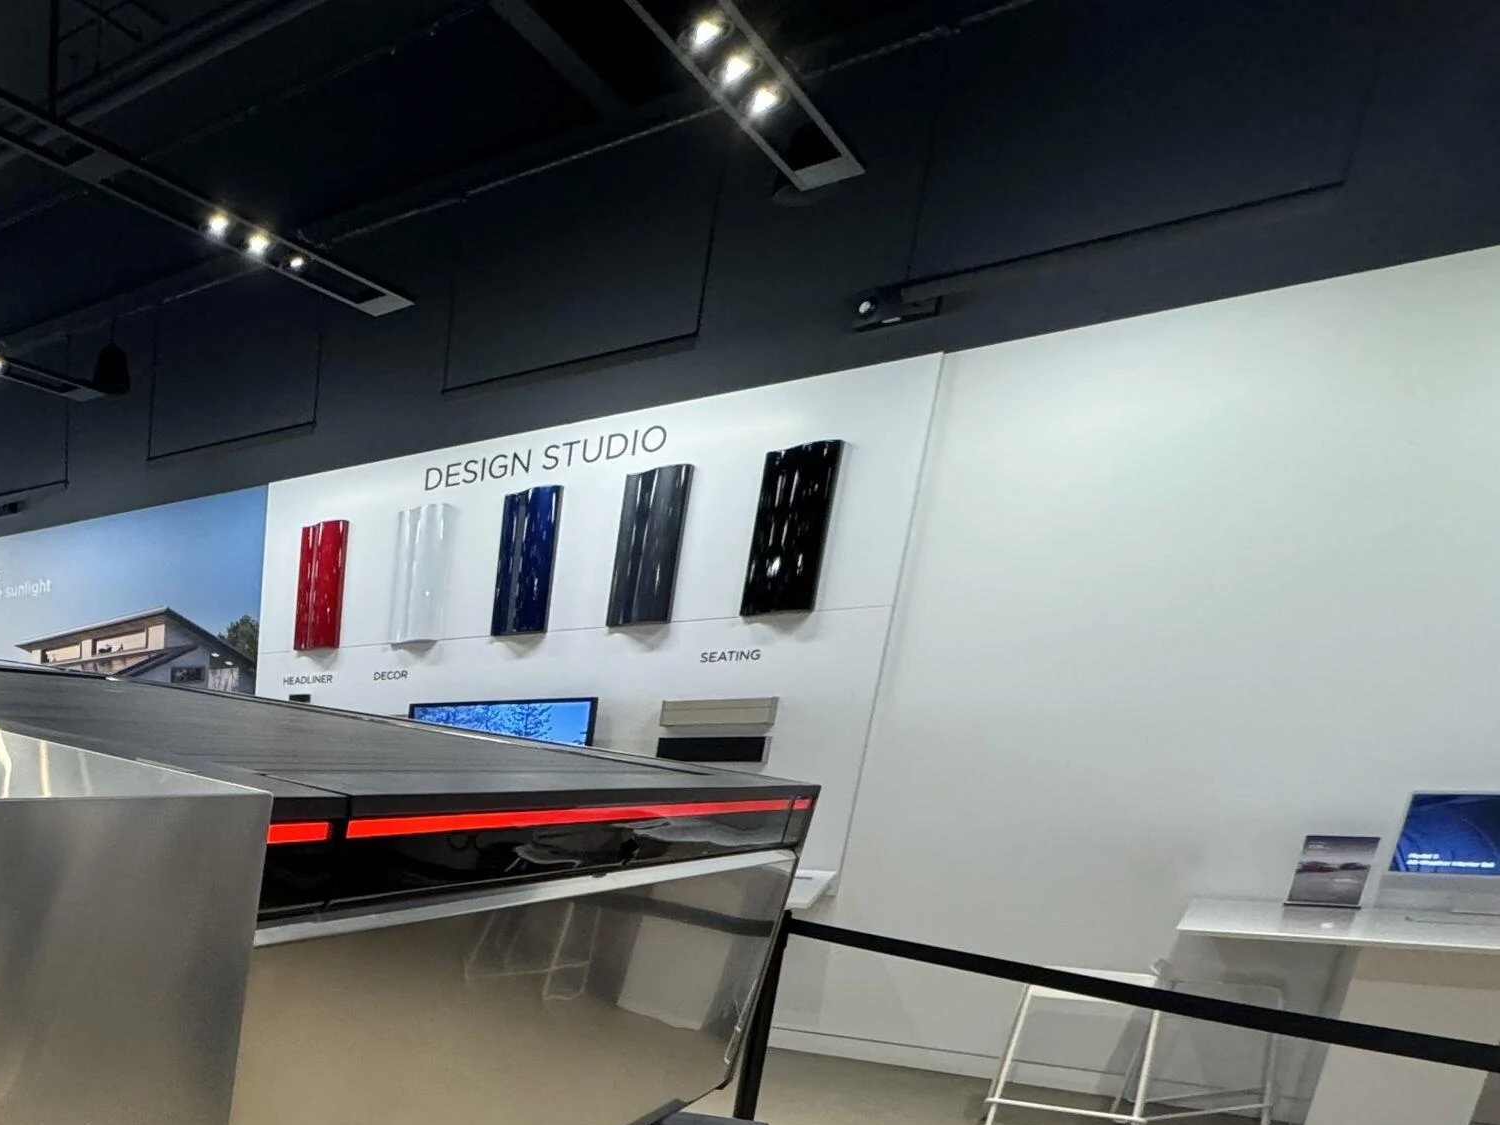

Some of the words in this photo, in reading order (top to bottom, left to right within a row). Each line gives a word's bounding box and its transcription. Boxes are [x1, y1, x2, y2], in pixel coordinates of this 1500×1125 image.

[424, 449, 532, 491] DESIGN
[542, 425, 667, 470] STUDIO
[5, 578, 52, 597] sunlight
[700, 649, 761, 663] SEATING
[283, 674, 334, 685] HEADLINER
[373, 670, 408, 681] DECOR
